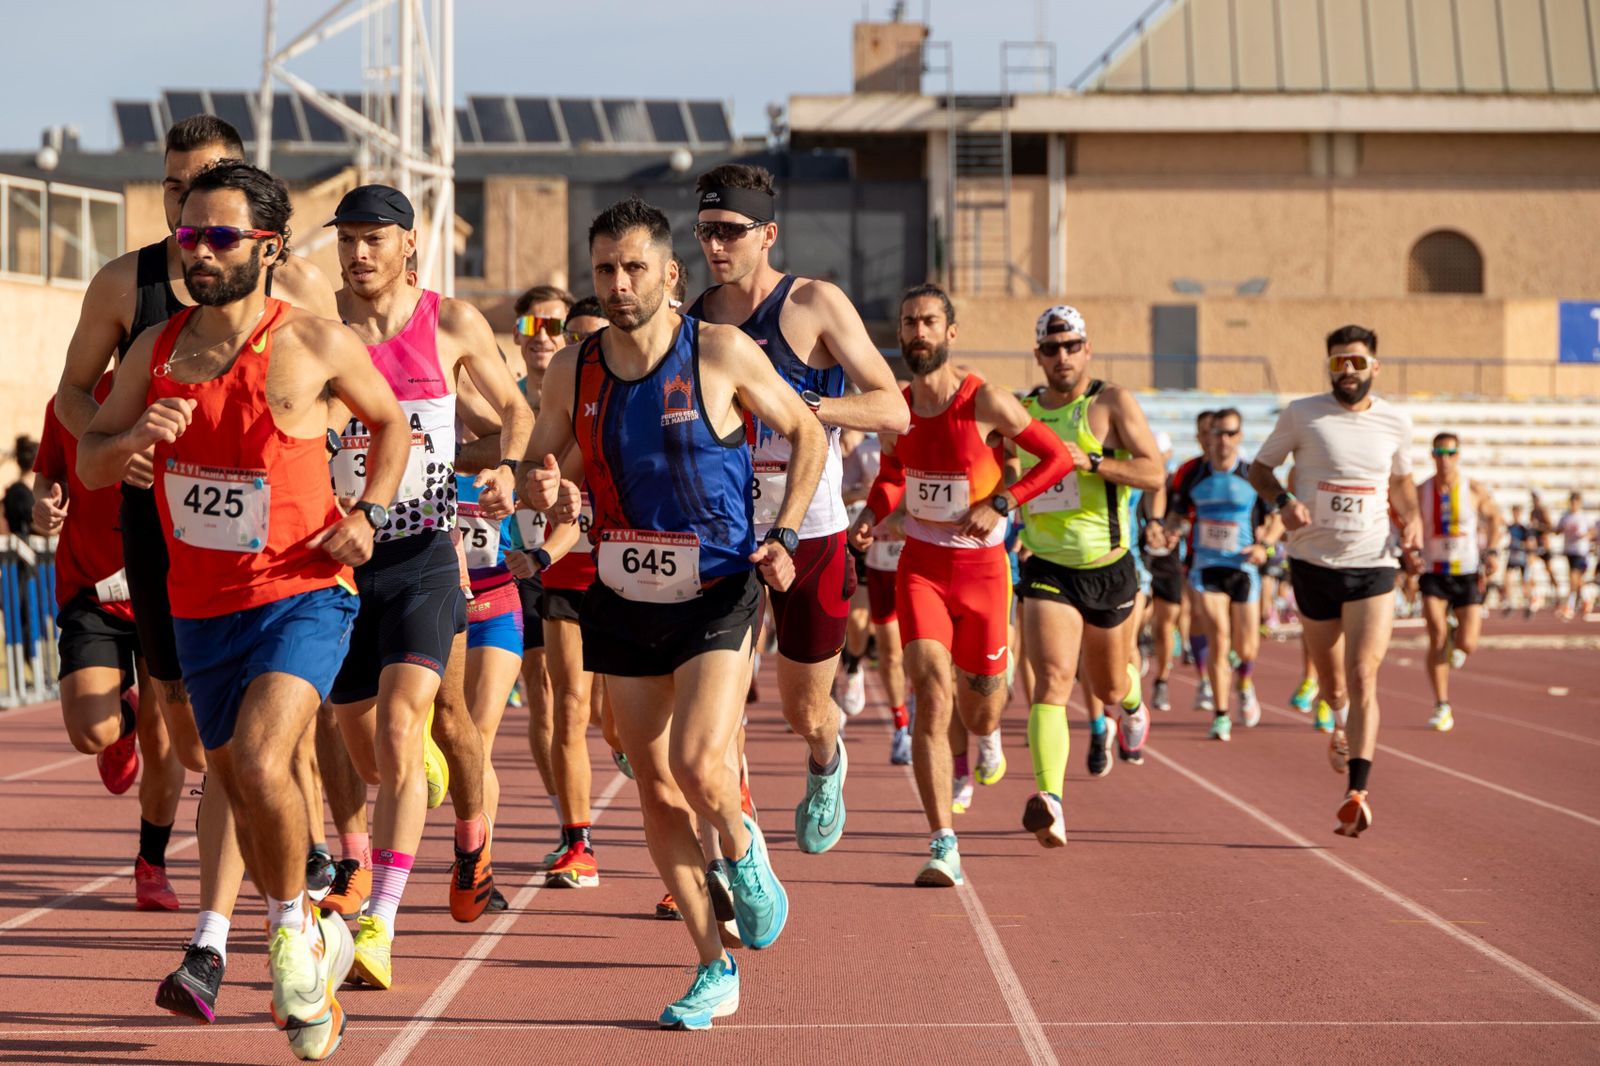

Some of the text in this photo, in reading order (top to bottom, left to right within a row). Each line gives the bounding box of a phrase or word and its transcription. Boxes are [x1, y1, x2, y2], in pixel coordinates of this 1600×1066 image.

[184, 484, 244, 518] 425
[919, 483, 952, 502] 571
[1331, 496, 1364, 513] 621
[532, 513, 545, 528] 4
[459, 527, 488, 548] 75
[622, 547, 677, 577] 645
